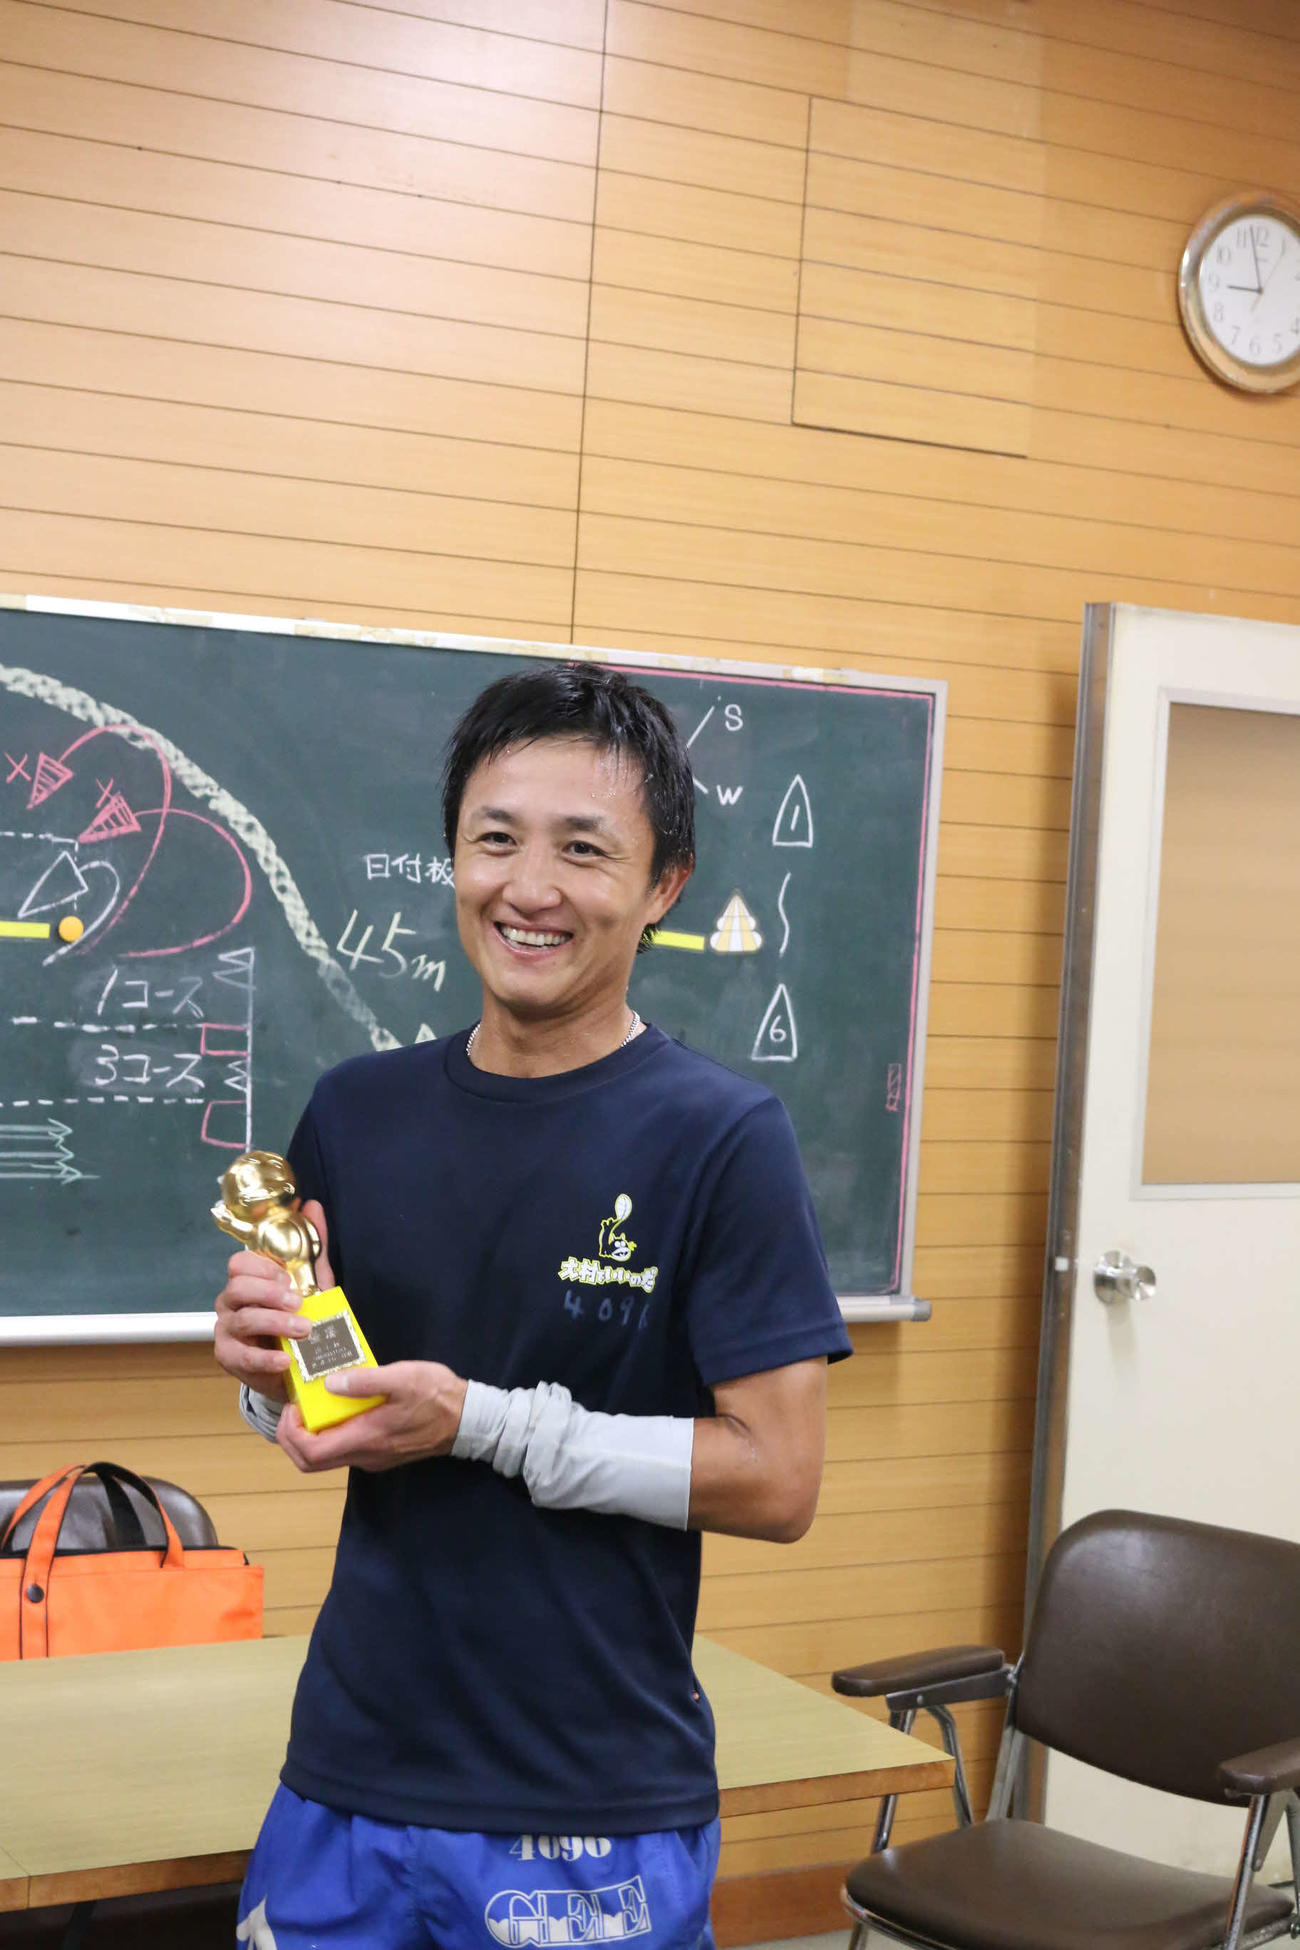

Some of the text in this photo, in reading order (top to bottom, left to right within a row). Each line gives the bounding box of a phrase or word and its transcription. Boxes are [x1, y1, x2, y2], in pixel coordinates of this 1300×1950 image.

[1236, 226, 1248, 249] 11
[1256, 226, 1269, 248] 12
[1216, 246, 1232, 265] 10
[1208, 272, 1221, 292] 9
[1212, 302, 1225, 322] 8
[1231, 325, 1241, 345] 7
[1248, 336, 1262, 356] 6
[1273, 333, 1283, 354] 5
[724, 704, 744, 731] S
[790, 804, 801, 832] 1
[366, 852, 455, 888] 日付板
[336, 908, 447, 992] 45m
[769, 1014, 787, 1042] 6
[94, 1043, 205, 1088] 3コース
[508, 1834, 612, 1862] 4096
